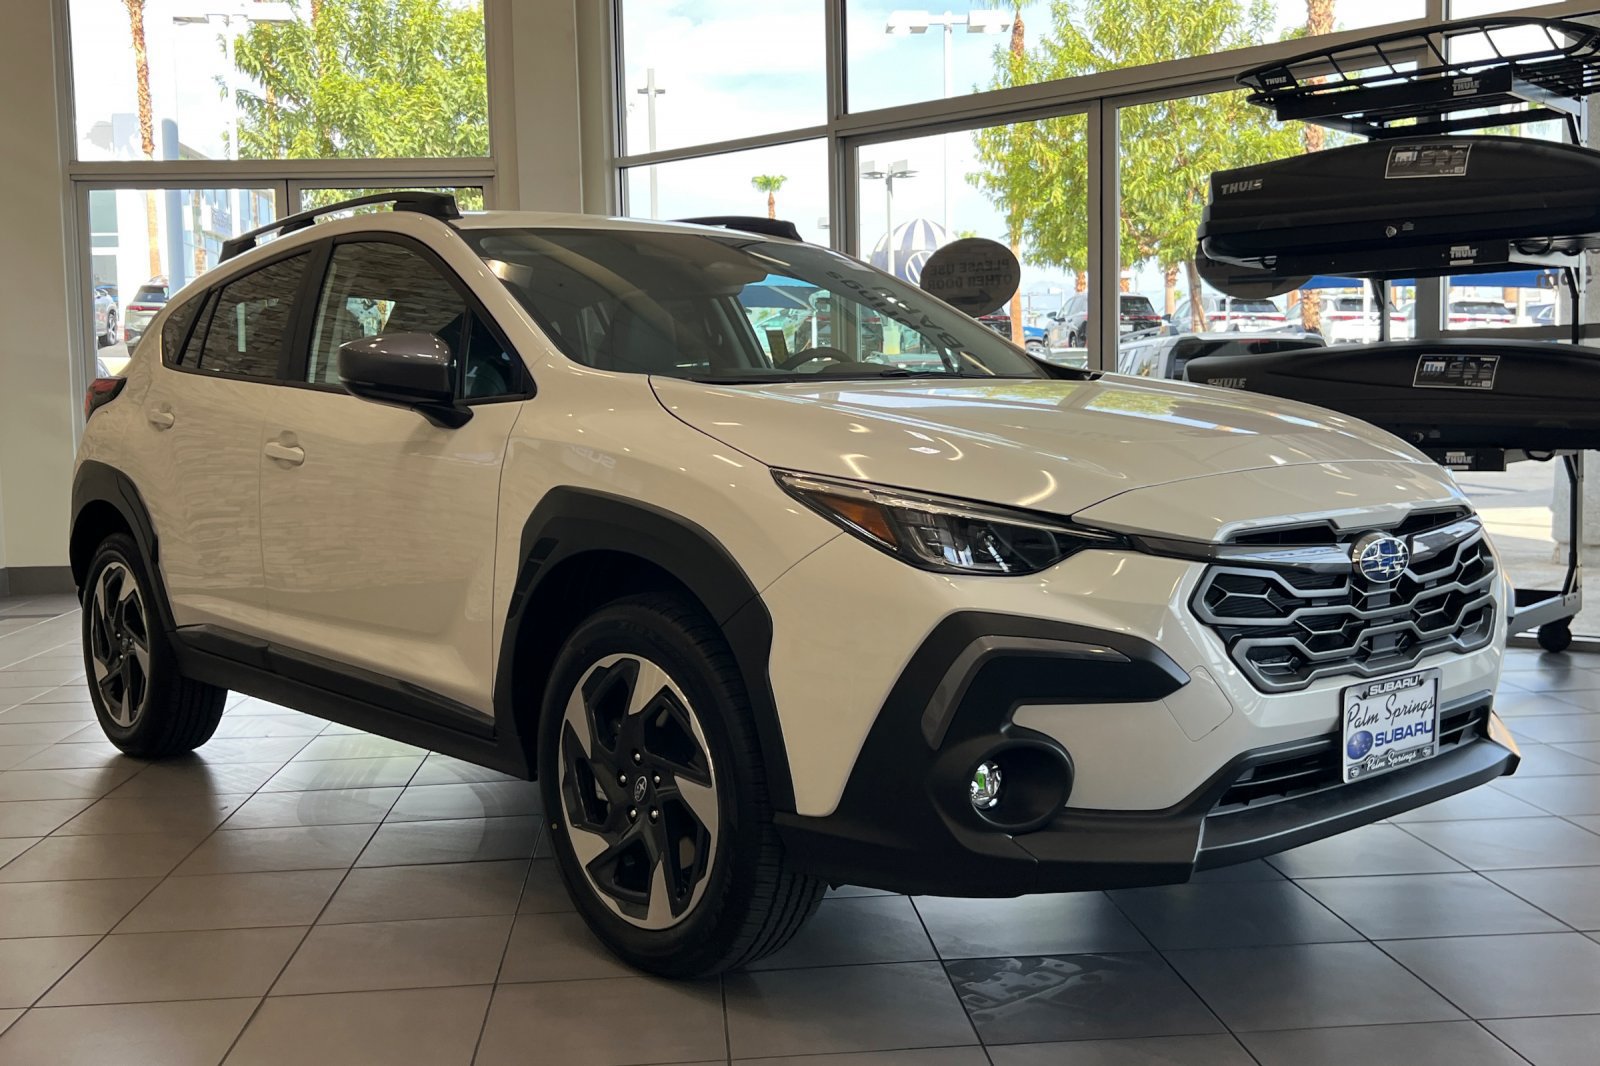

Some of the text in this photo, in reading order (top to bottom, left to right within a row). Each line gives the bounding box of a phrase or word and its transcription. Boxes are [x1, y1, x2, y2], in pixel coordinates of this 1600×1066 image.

[1265, 76, 1287, 86] THULE
[1452, 80, 1480, 91] THULE
[1221, 179, 1263, 195] THULE
[1450, 248, 1477, 259] THULE
[1207, 377, 1247, 389] THULE
[1445, 455, 1474, 464] THULE
[1369, 676, 1418, 695] SUBARU
[1347, 693, 1434, 729] Palm Springs
[1375, 720, 1434, 747] SUBARU
[1366, 751, 1417, 771] Palm Springs
